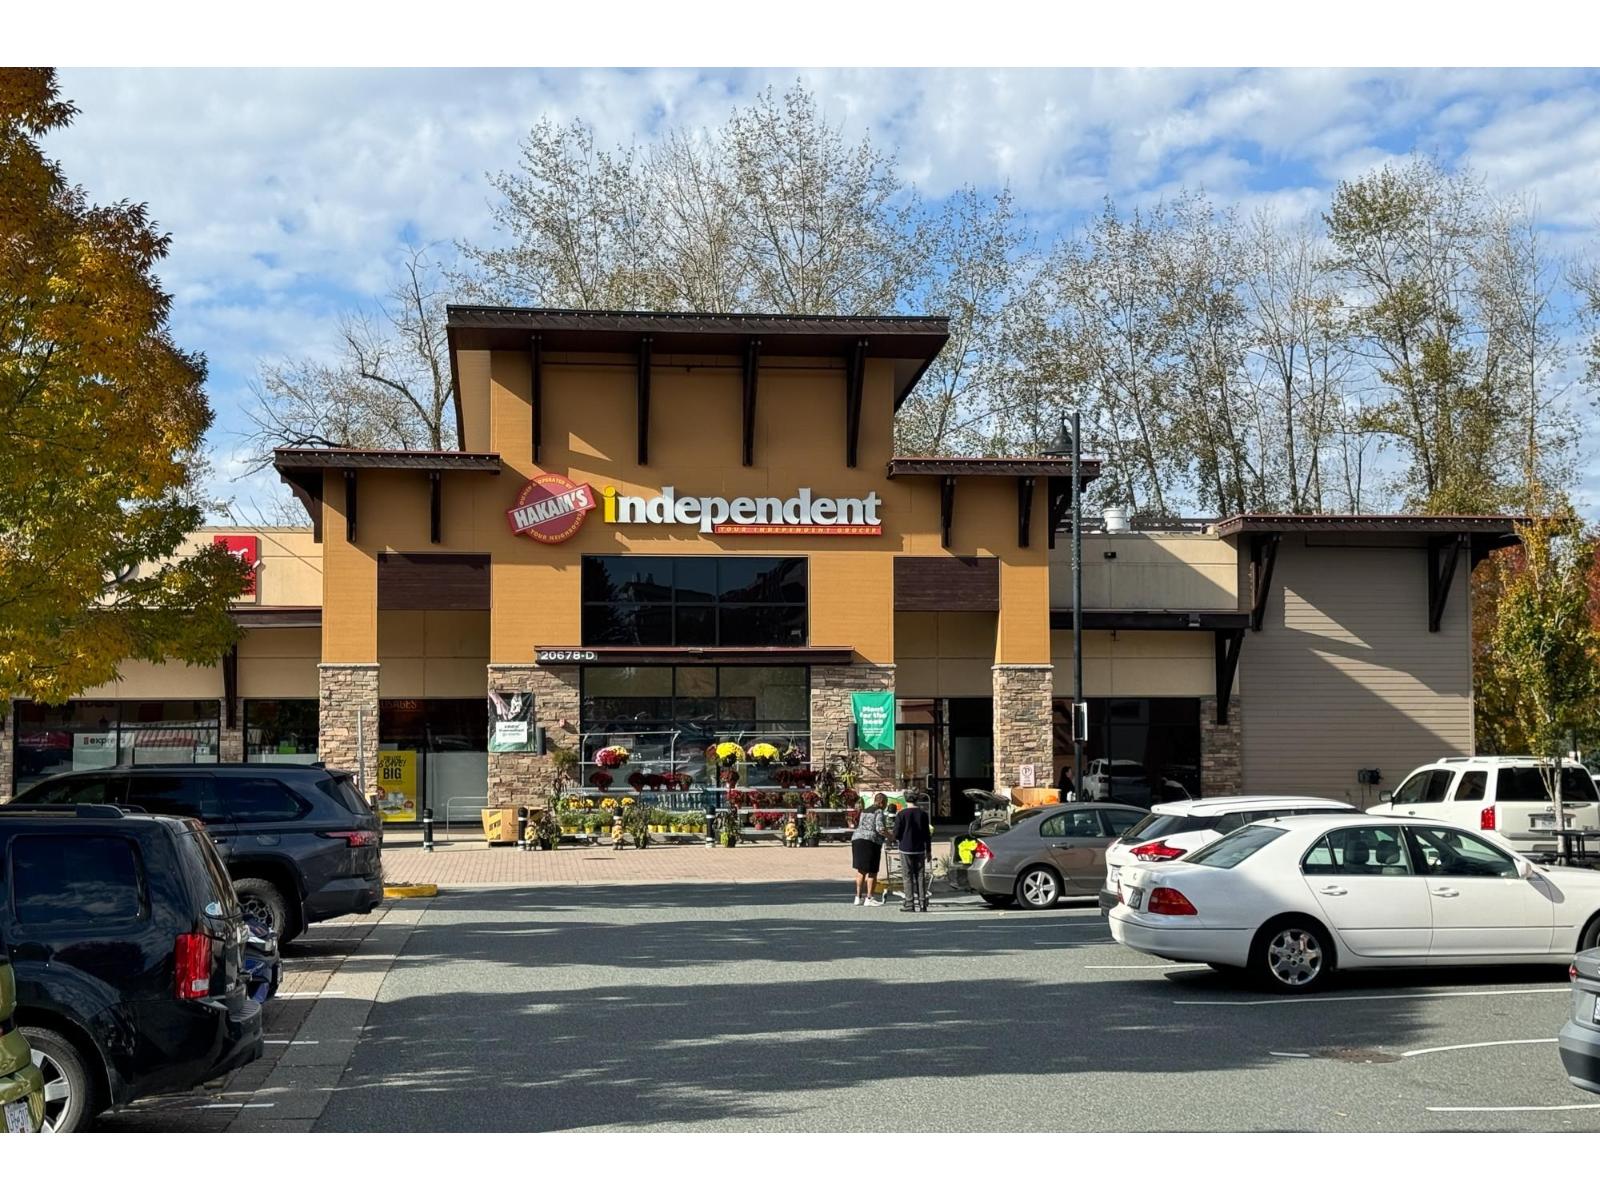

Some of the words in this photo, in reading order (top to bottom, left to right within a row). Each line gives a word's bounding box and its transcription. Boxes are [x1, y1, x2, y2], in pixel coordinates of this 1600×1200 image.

[513, 489, 588, 529] HAKAM'S
[603, 486, 882, 534] independent
[719, 526, 746, 534] YOUR
[753, 526, 830, 534] INDEPENDENT
[383, 768, 402, 779] BIG
